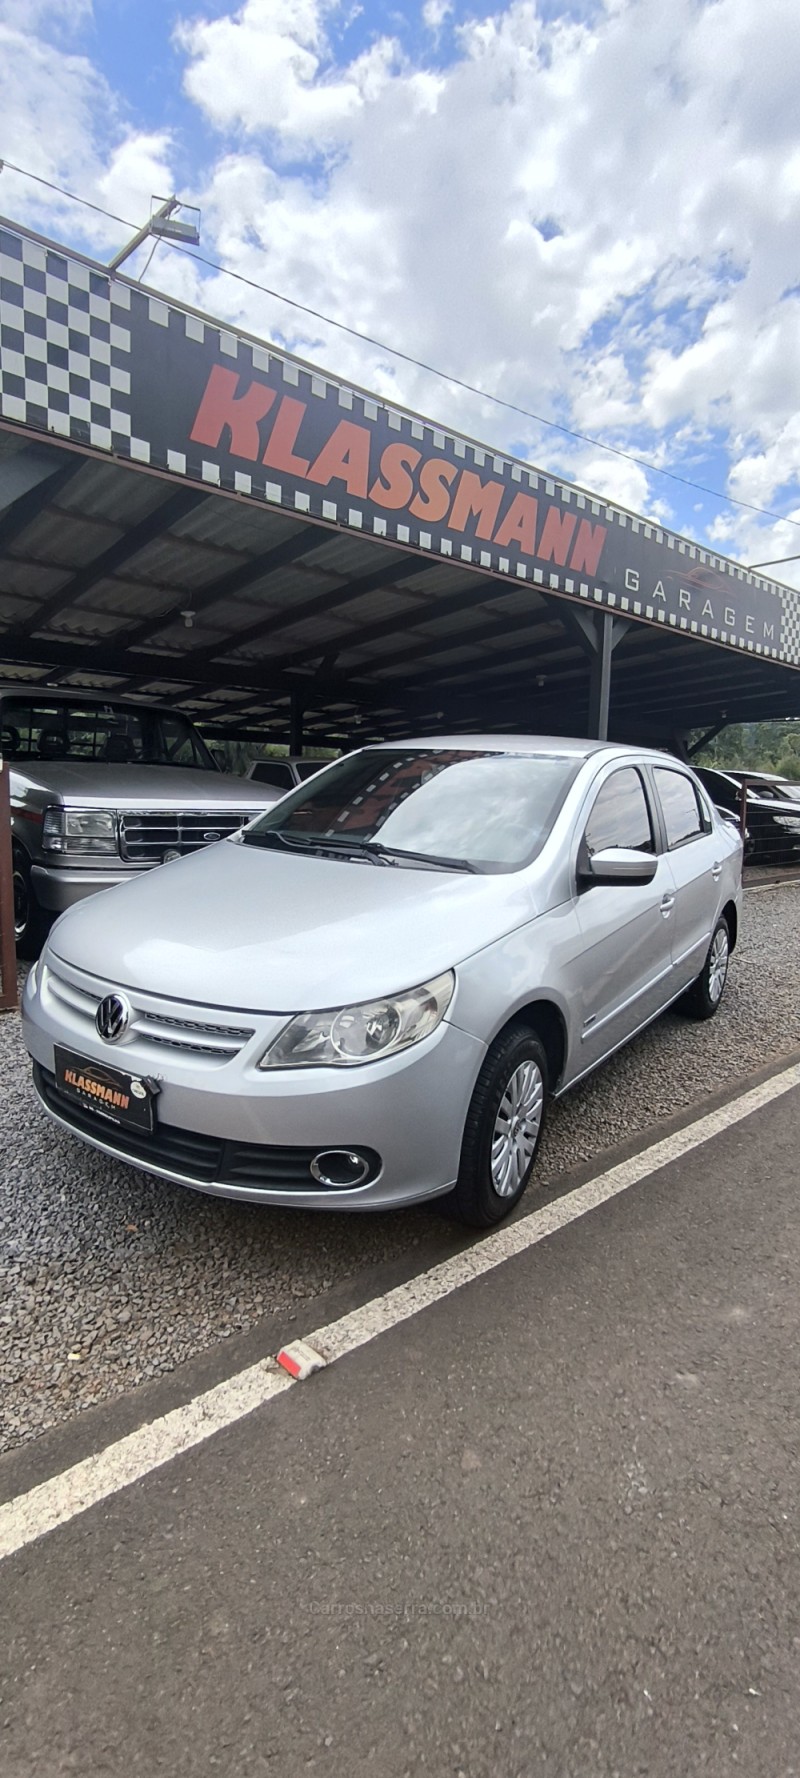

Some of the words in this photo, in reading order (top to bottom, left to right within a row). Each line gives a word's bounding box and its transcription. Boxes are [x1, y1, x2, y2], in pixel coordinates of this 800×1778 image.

[189, 363, 607, 577] KLASSMANN
[624, 568, 775, 641] GARAGEM
[64, 1068, 130, 1109] KLASSMANN
